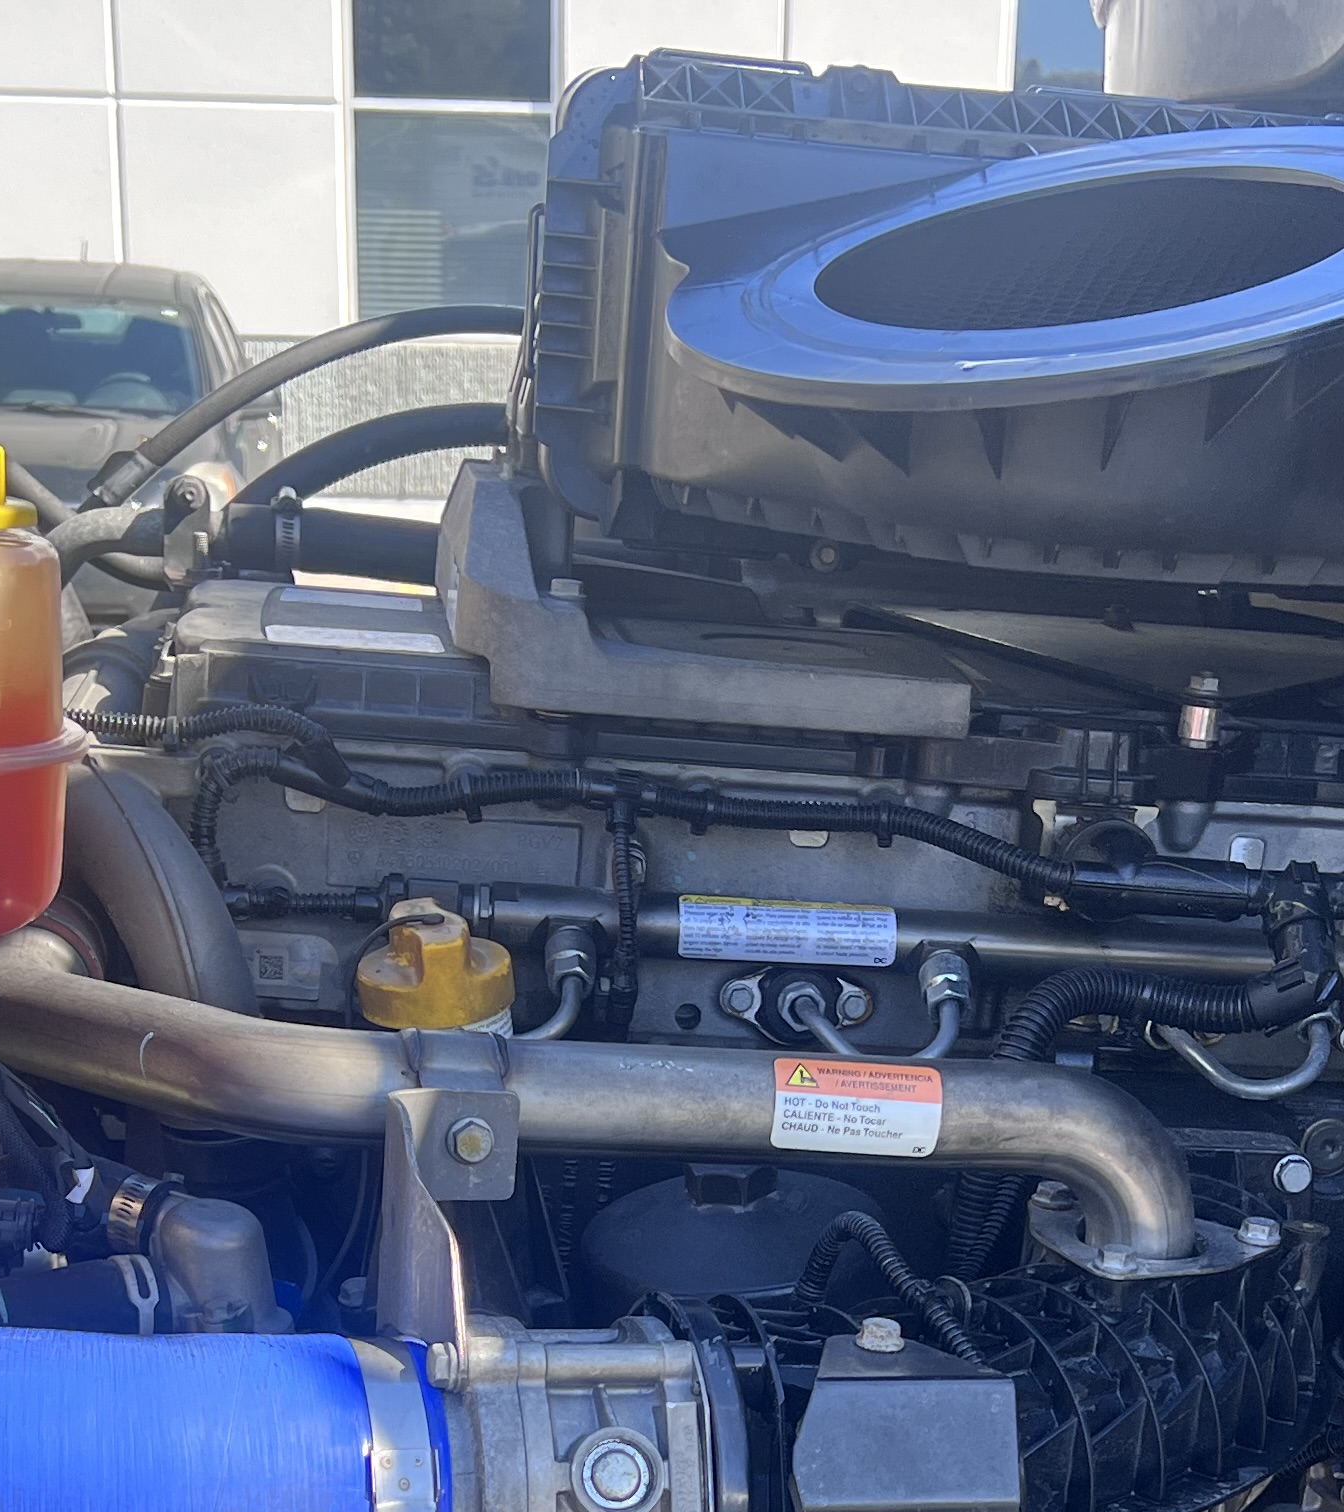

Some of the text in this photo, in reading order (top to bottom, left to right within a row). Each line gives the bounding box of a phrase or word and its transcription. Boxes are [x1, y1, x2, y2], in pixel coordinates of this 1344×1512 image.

[817, 1067, 861, 1078] WARNING
[868, 1070, 933, 1083] ADVERTENCIA
[840, 1079, 917, 1093] AVERTISSEMENT
[784, 1096, 806, 1107] HOT
[815, 1099, 829, 1109] Do
[831, 1100, 849, 1111] Not
[851, 1102, 881, 1113] Touch
[783, 1108, 835, 1122] CALIENTE
[843, 1114, 857, 1124] No
[859, 1115, 887, 1126] Tocar
[781, 1121, 819, 1133] CHAUD
[826, 1125, 840, 1135] Ne
[843, 1127, 860, 1137] Pas
[863, 1128, 903, 1140] Toucher
